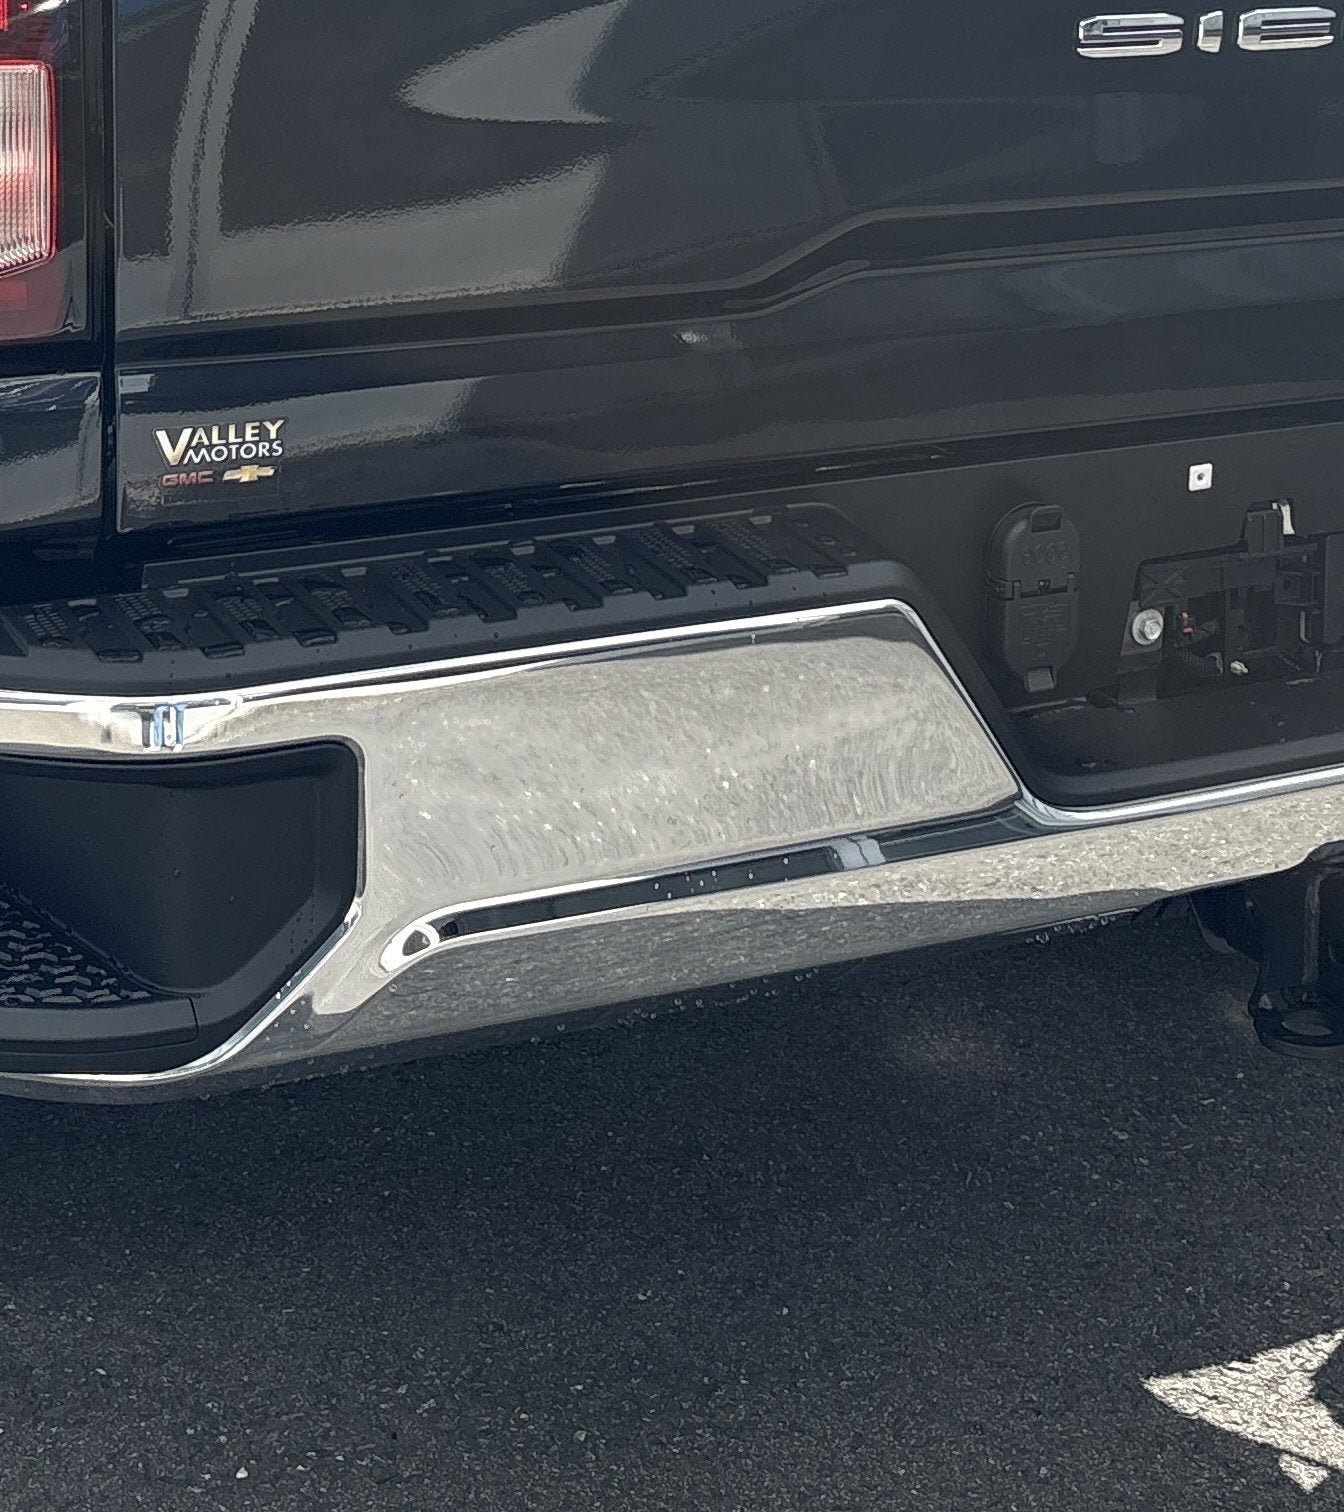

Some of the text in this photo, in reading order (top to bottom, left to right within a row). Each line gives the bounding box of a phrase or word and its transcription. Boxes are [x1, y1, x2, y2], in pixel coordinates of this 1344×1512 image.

[154, 419, 286, 467] VALLEY
[182, 439, 284, 465] MOTORS
[161, 469, 215, 487] GMC
